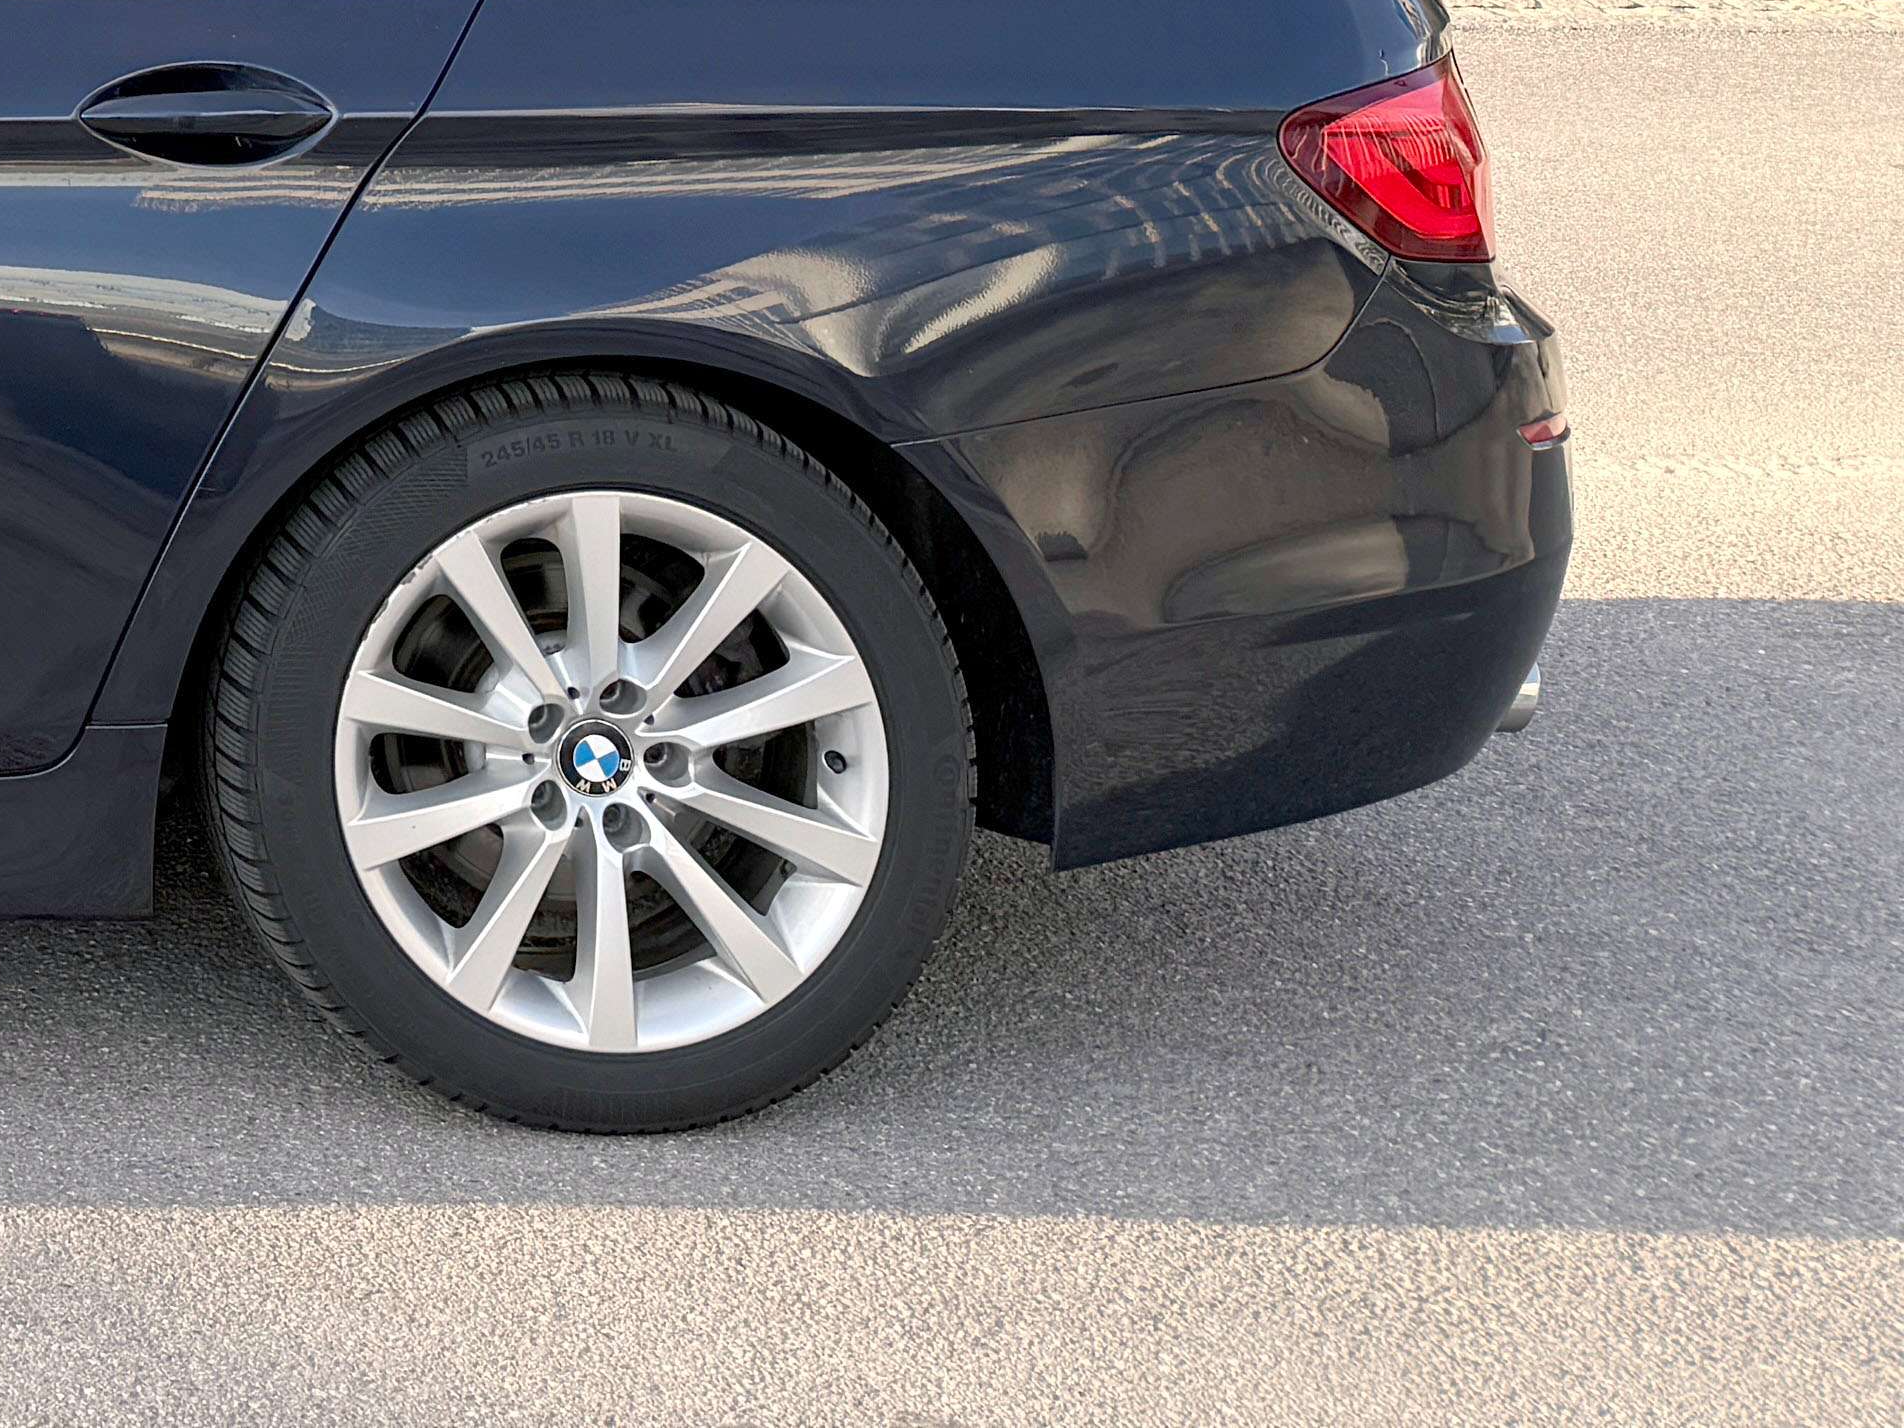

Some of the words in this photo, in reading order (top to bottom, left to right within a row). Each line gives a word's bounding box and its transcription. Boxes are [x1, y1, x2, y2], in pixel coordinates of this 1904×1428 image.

[481, 434, 560, 467] 245/45
[568, 431, 584, 448] R
[593, 430, 616, 446] 18
